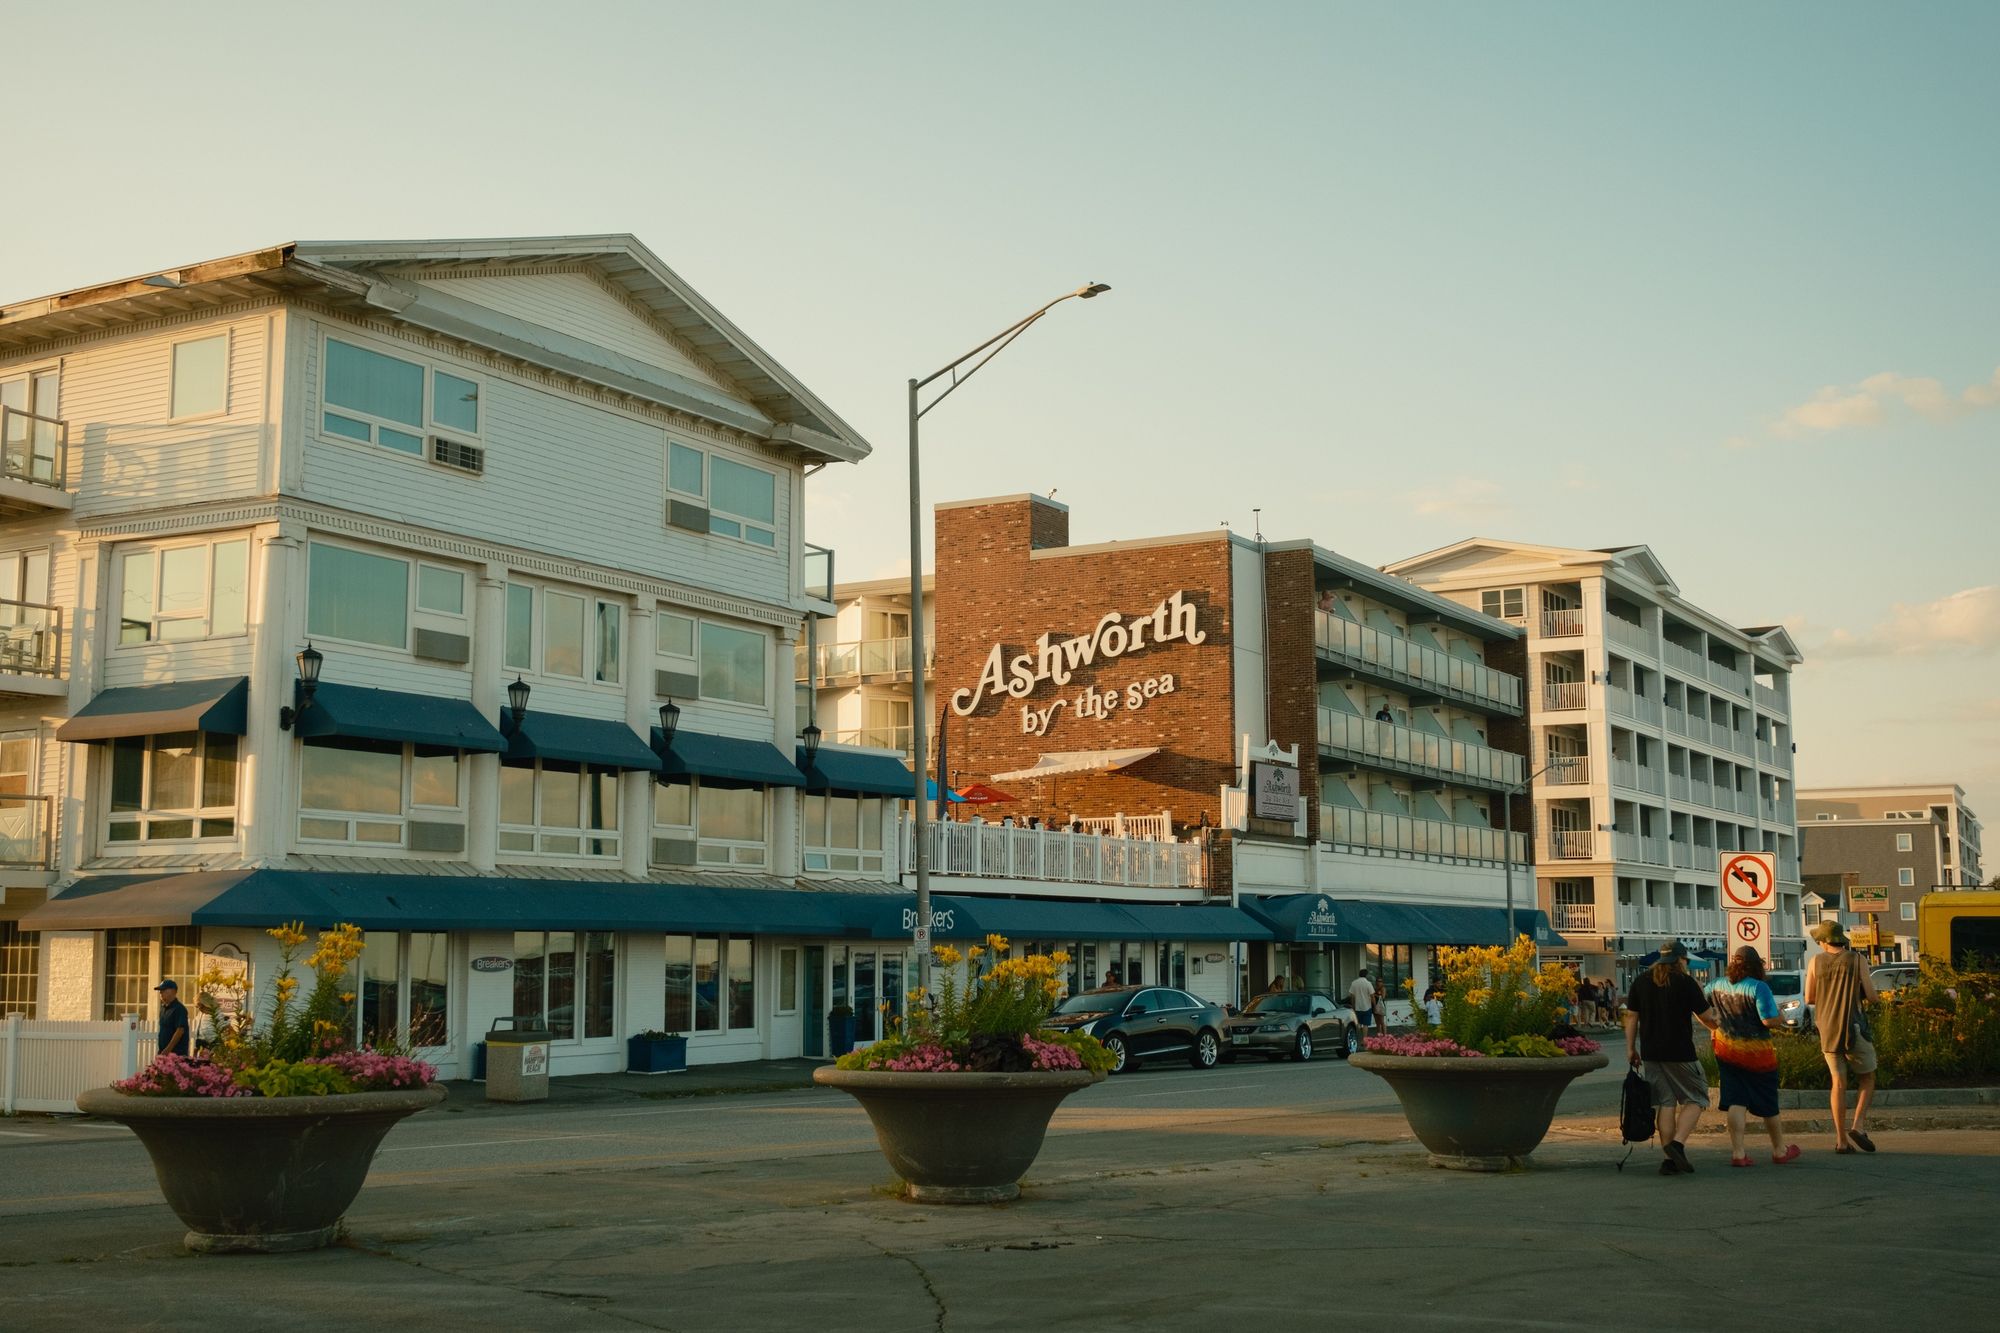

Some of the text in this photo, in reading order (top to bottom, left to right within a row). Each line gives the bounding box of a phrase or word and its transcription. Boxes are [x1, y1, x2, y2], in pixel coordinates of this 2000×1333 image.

[952, 590, 1206, 716] Ashworth
[1020, 673, 1174, 736] by the sea
[903, 905, 954, 930] Brkers
[477, 958, 510, 969] Breakers
